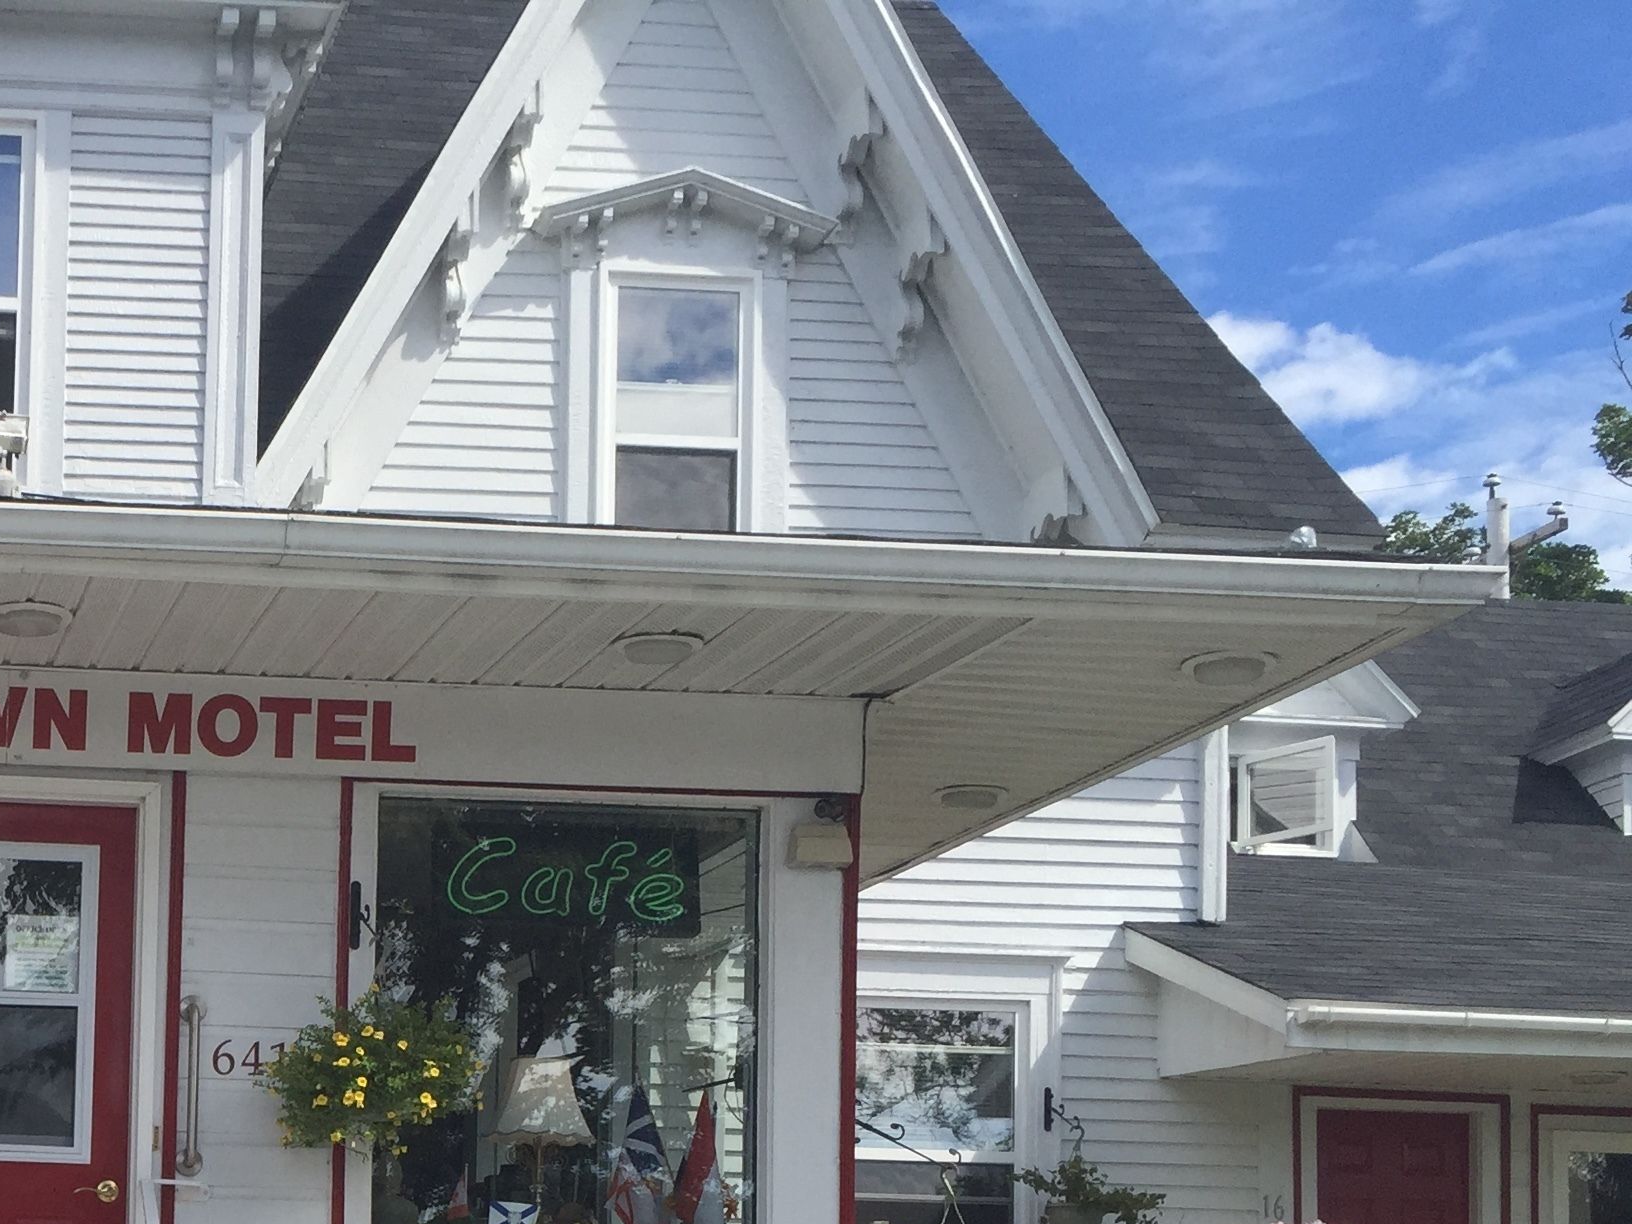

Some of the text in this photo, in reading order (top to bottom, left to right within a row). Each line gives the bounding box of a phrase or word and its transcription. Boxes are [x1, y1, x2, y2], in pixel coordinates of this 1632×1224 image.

[126, 690, 417, 763] MOTEL
[447, 836, 685, 921] Café
[1263, 1194, 1285, 1221] 16
